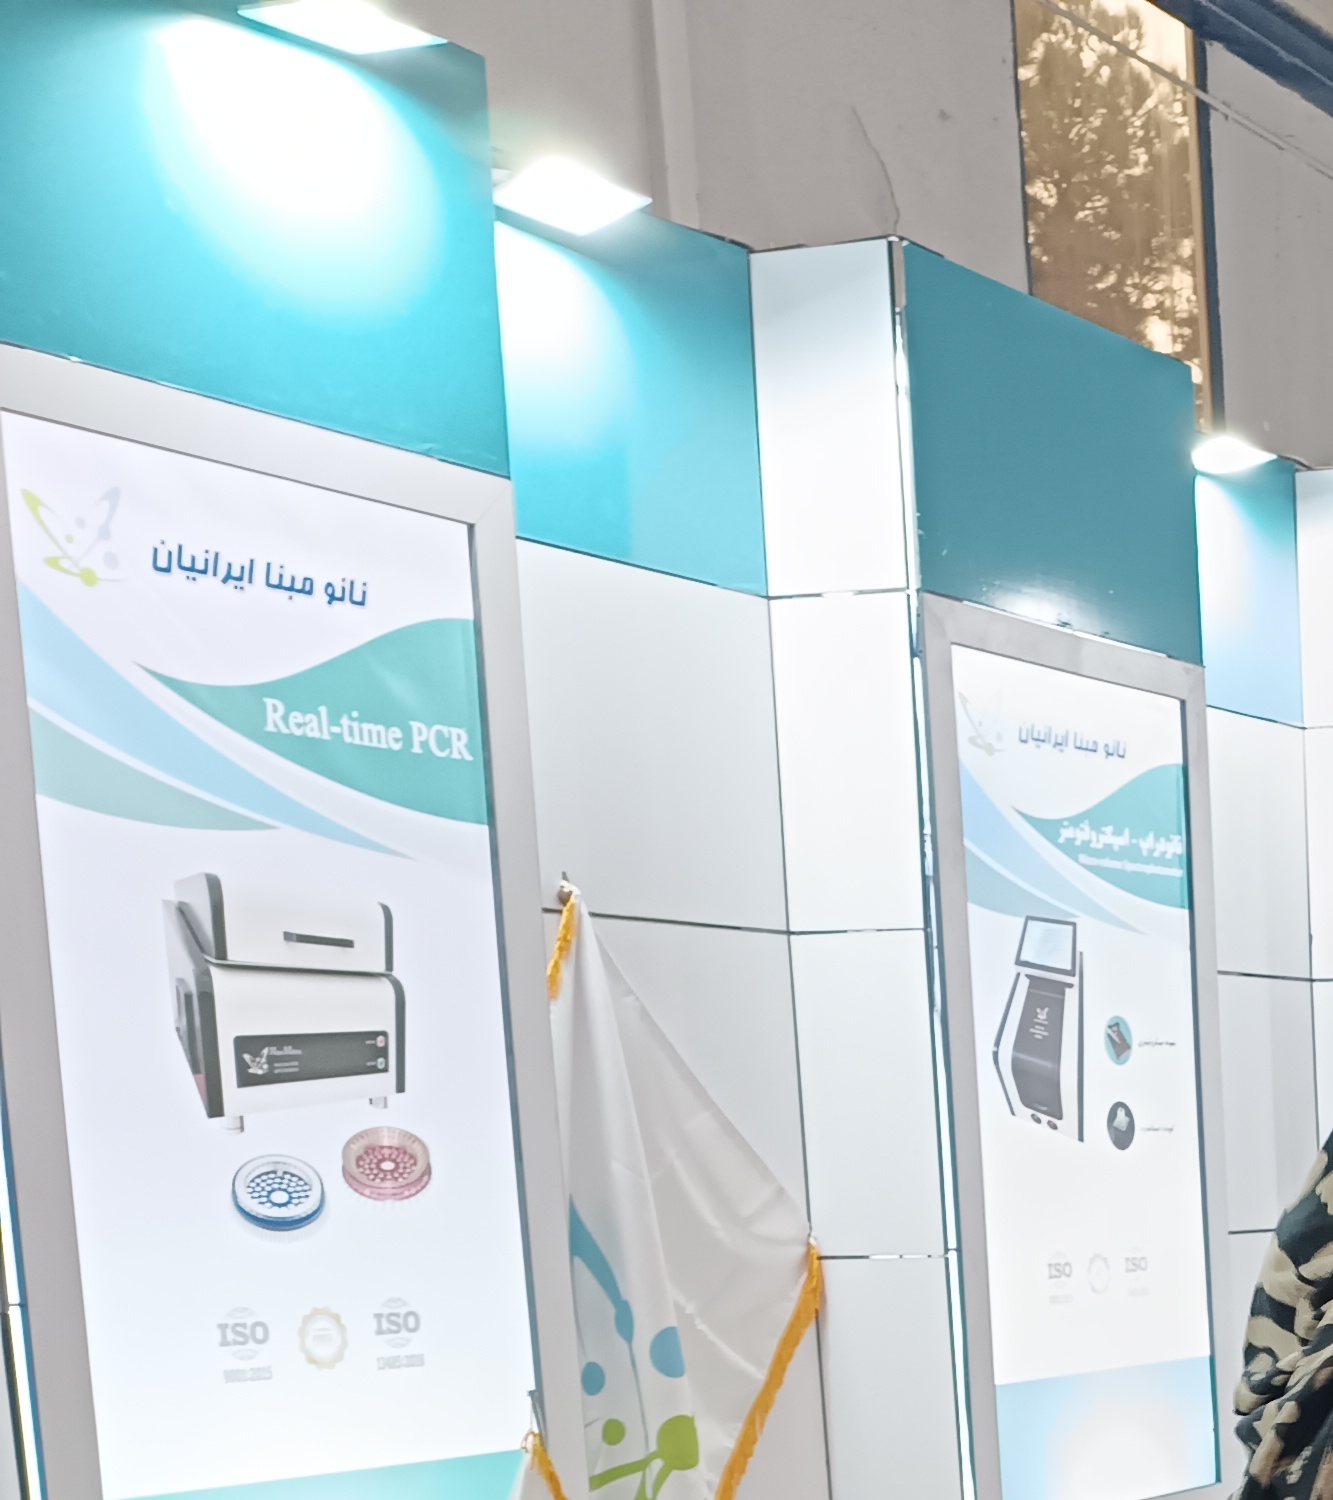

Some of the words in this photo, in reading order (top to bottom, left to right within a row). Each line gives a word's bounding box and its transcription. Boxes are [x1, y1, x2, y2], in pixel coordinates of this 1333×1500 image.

[152, 539, 254, 591] ایرانیان
[265, 562, 314, 600] مبنا
[324, 578, 367, 606] نانو
[262, 697, 403, 751] Real-time
[409, 720, 474, 761] PCR
[1047, 1262, 1073, 1279] ISO
[1124, 1256, 1149, 1273] ISO
[217, 1321, 270, 1347] ISO
[373, 1310, 421, 1336] ISO
